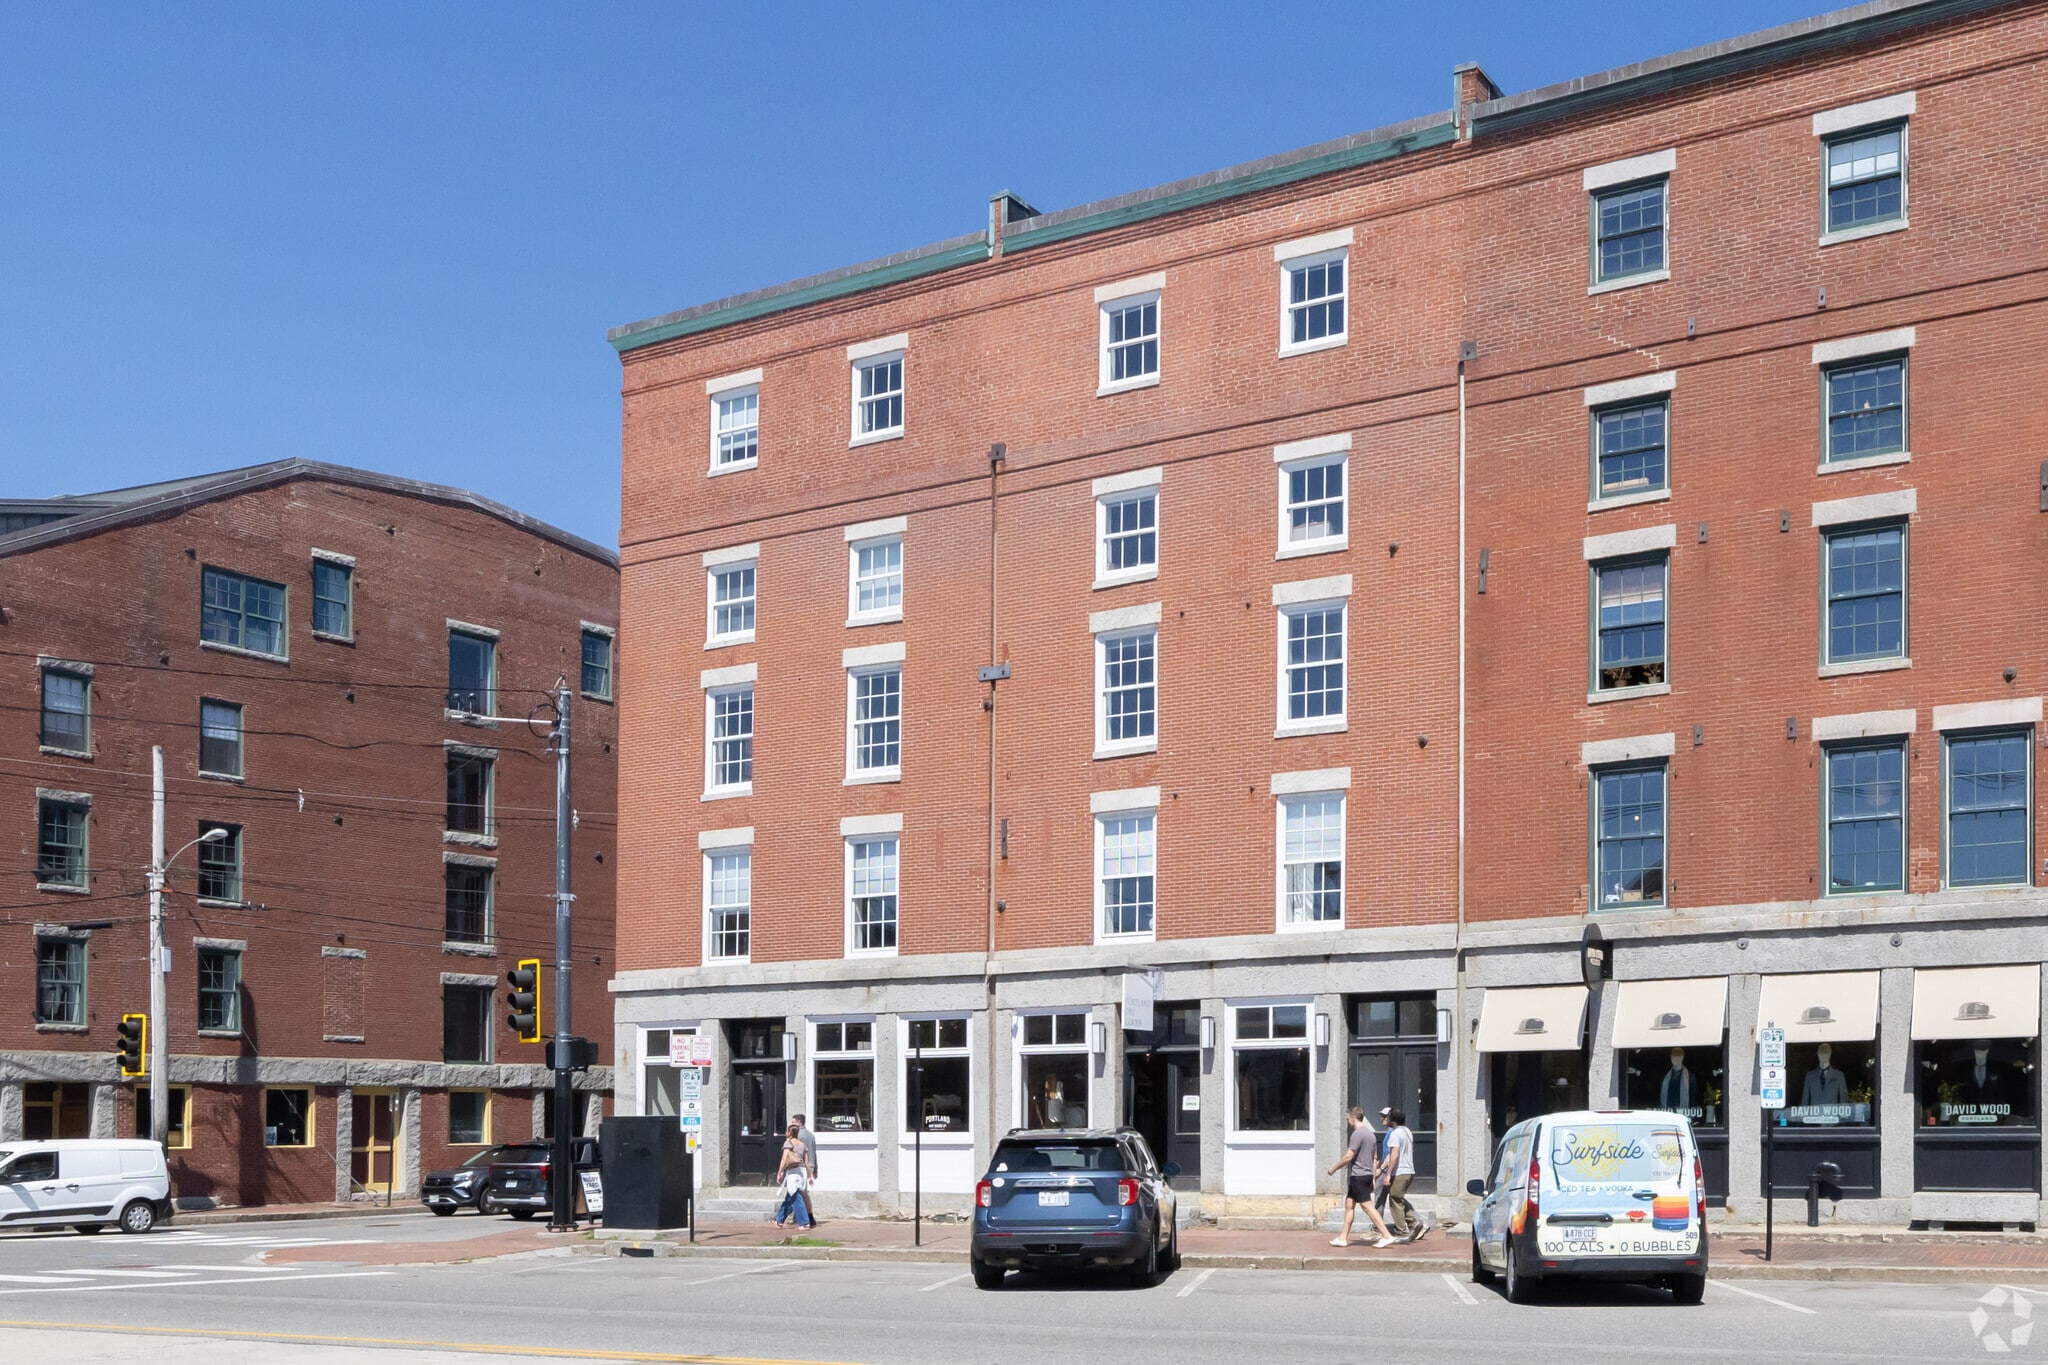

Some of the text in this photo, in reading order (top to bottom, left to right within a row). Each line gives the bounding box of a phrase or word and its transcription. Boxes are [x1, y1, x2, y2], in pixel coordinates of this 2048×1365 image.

[1676, 1107, 1703, 1118] WOOD
[1791, 1105, 1852, 1117] DAVID WOOD
[1945, 1104, 2010, 1115] DAVID WOOD
[831, 1115, 855, 1124] PORTLAND
[925, 1115, 950, 1124] PORTLAND
[1552, 1133, 1644, 1166] Surfside
[1561, 1185, 1577, 1193] CED
[1545, 1241, 1691, 1252] 100 CALS 0 BUBBLES
